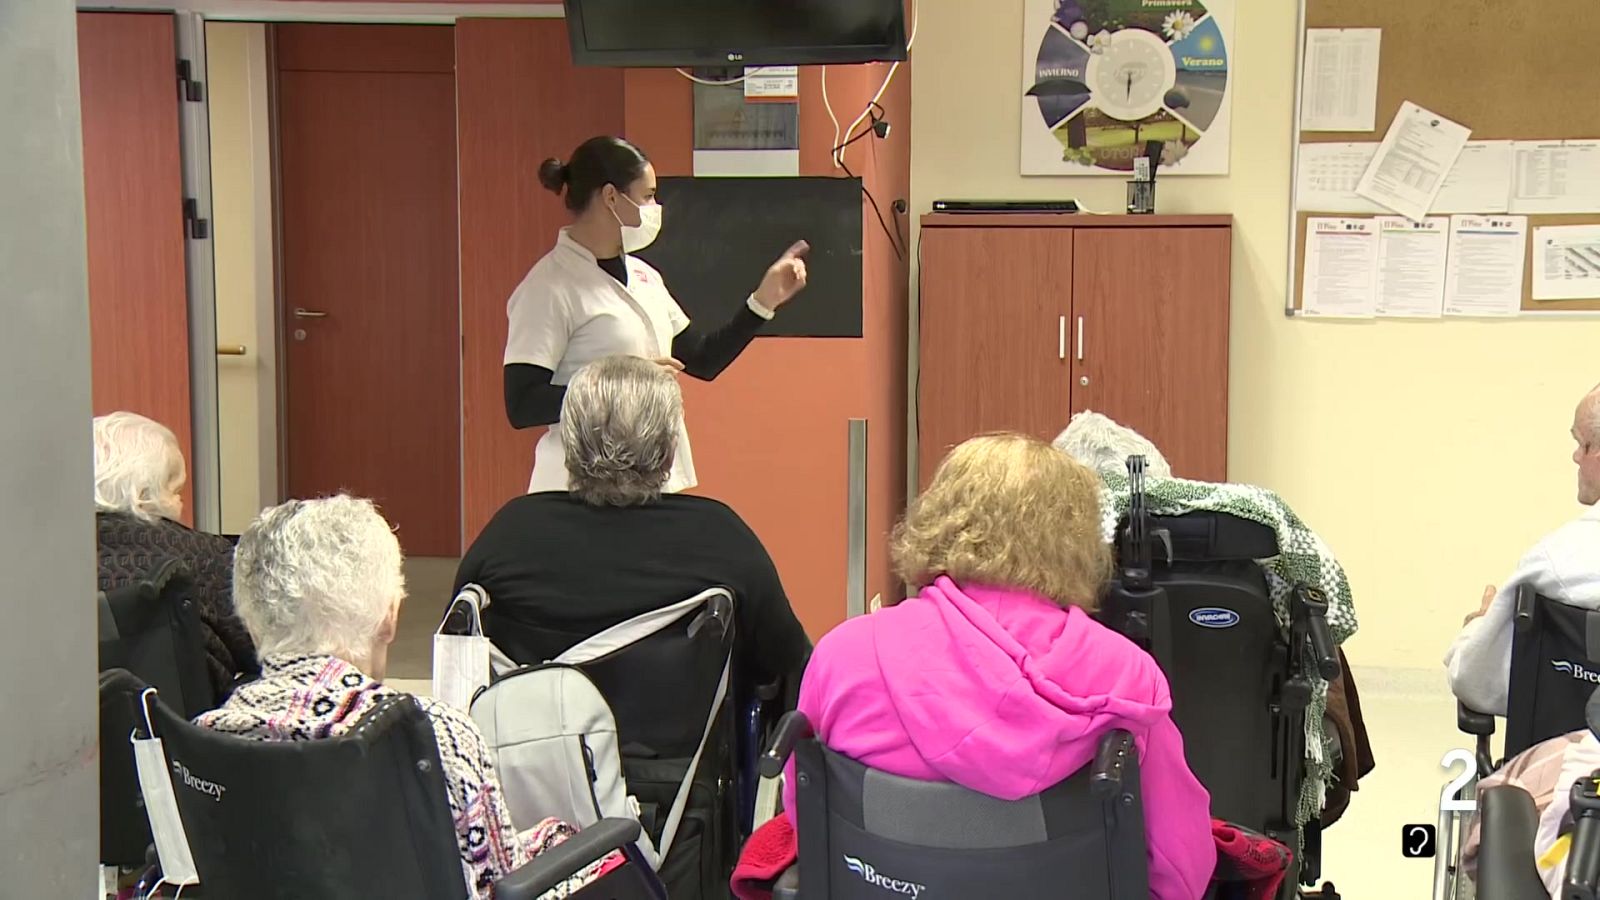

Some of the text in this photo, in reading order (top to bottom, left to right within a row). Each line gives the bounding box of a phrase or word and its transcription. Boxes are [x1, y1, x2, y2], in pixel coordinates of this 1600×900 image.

[1039, 68, 1079, 77] INVIERNO
[1182, 56, 1224, 66] Verano
[182, 765, 223, 802] Breezy
[864, 862, 921, 900] Breezy
